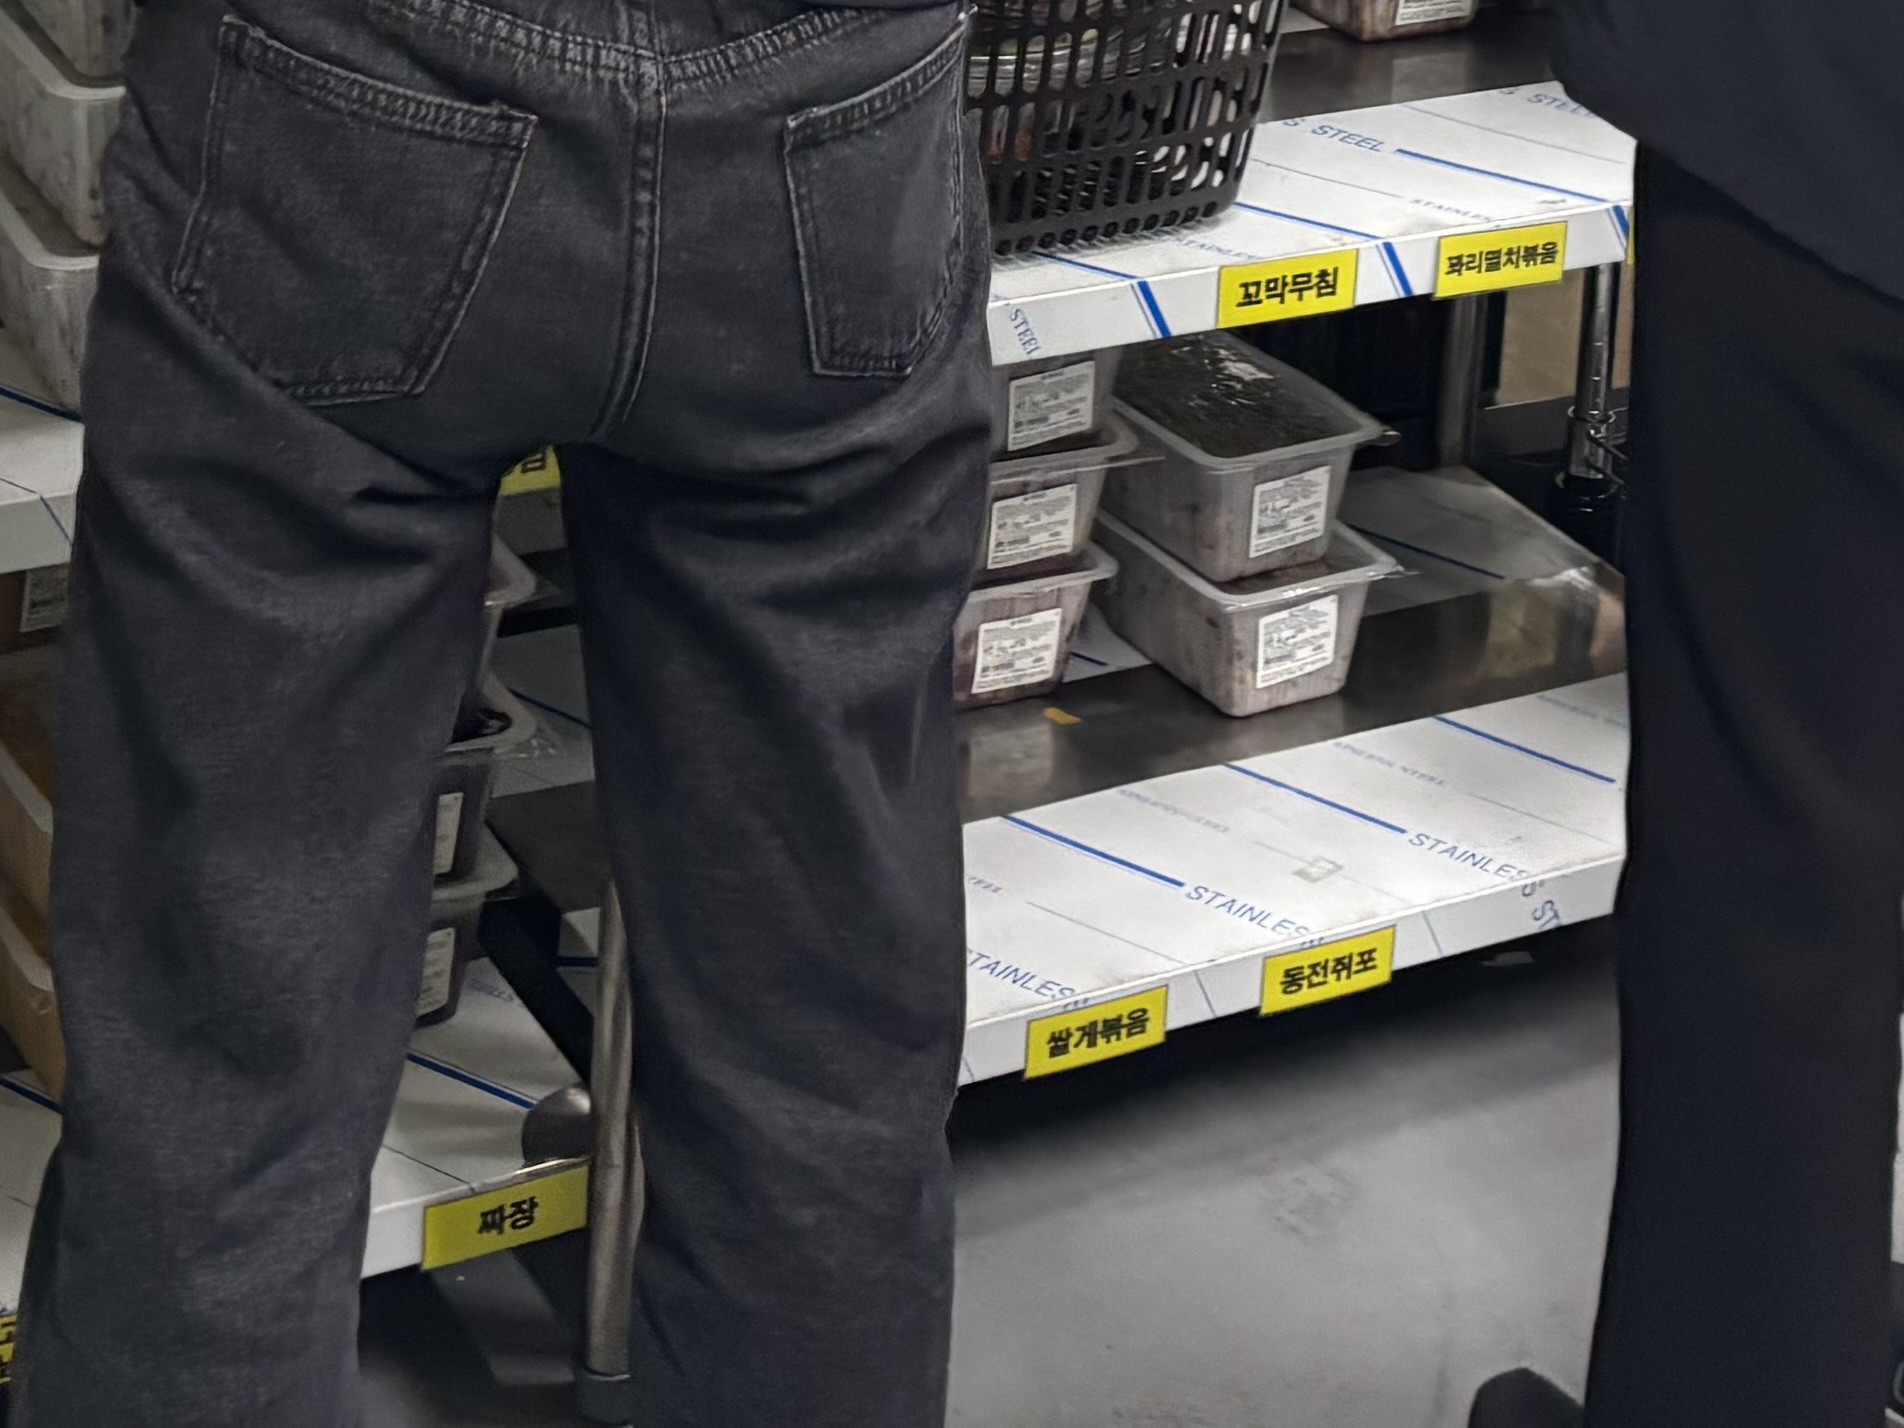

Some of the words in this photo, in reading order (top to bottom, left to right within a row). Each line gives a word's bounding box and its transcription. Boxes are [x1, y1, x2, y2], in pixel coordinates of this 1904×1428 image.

[1444, 241, 1558, 277] 꽈리멸치볶음
[1235, 266, 1340, 308] 꼬막무침
[1279, 947, 1378, 995] 동전쥐포
[475, 1196, 539, 1236] 짜장
